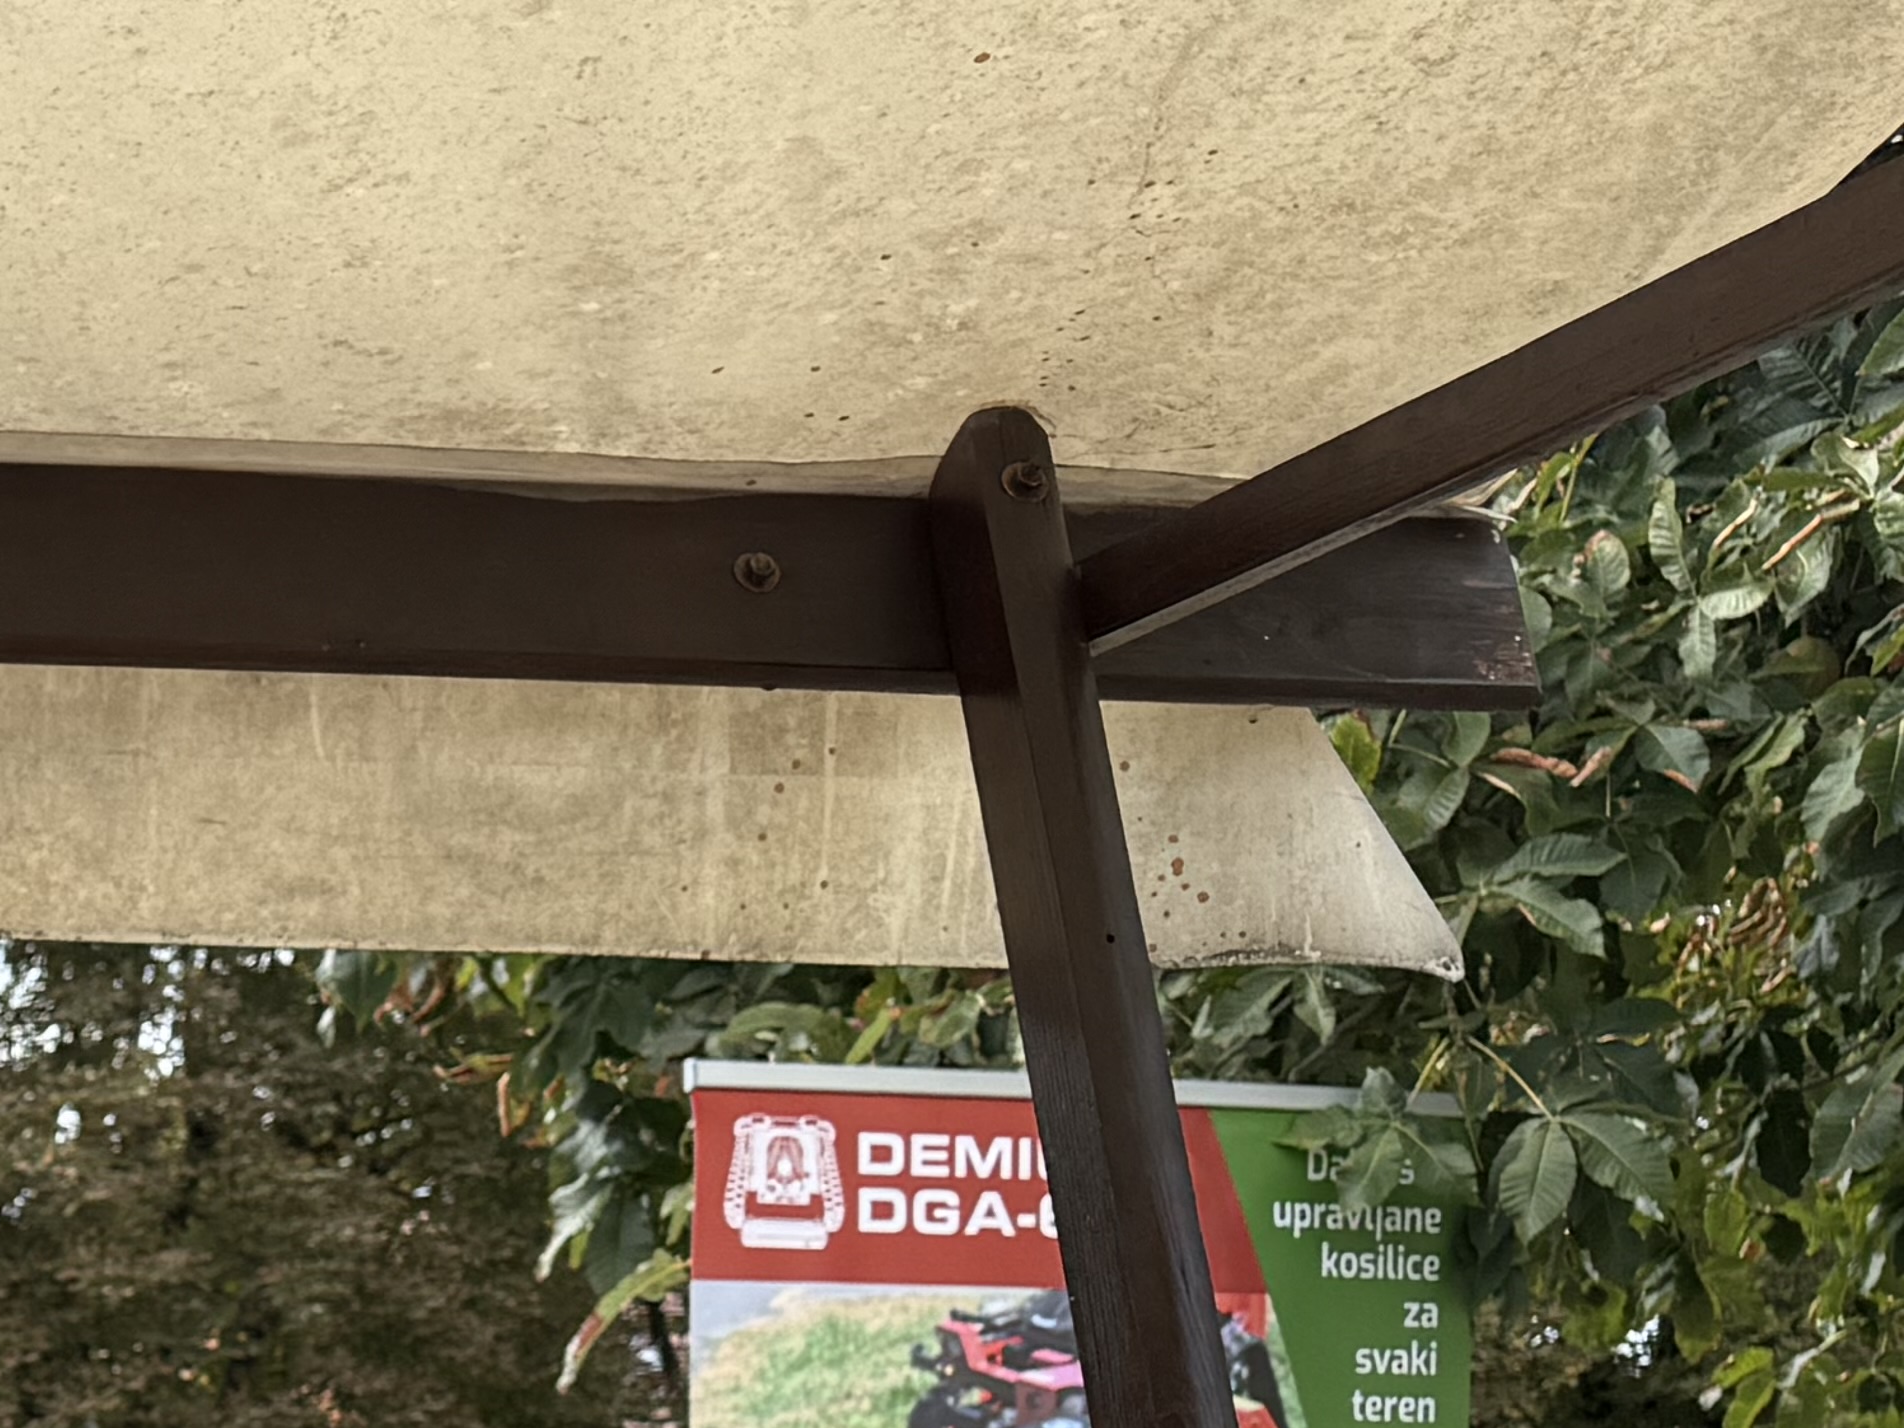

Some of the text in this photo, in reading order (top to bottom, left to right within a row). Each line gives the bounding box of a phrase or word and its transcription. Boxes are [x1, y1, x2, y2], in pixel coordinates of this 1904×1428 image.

[857, 1131, 1049, 1181] DEMI
[1272, 1201, 1442, 1242] upravljane
[1321, 1241, 1441, 1282] kosilice
[1403, 1301, 1439, 1329] za
[1355, 1339, 1438, 1377] svaki
[1351, 1389, 1437, 1424] teren
